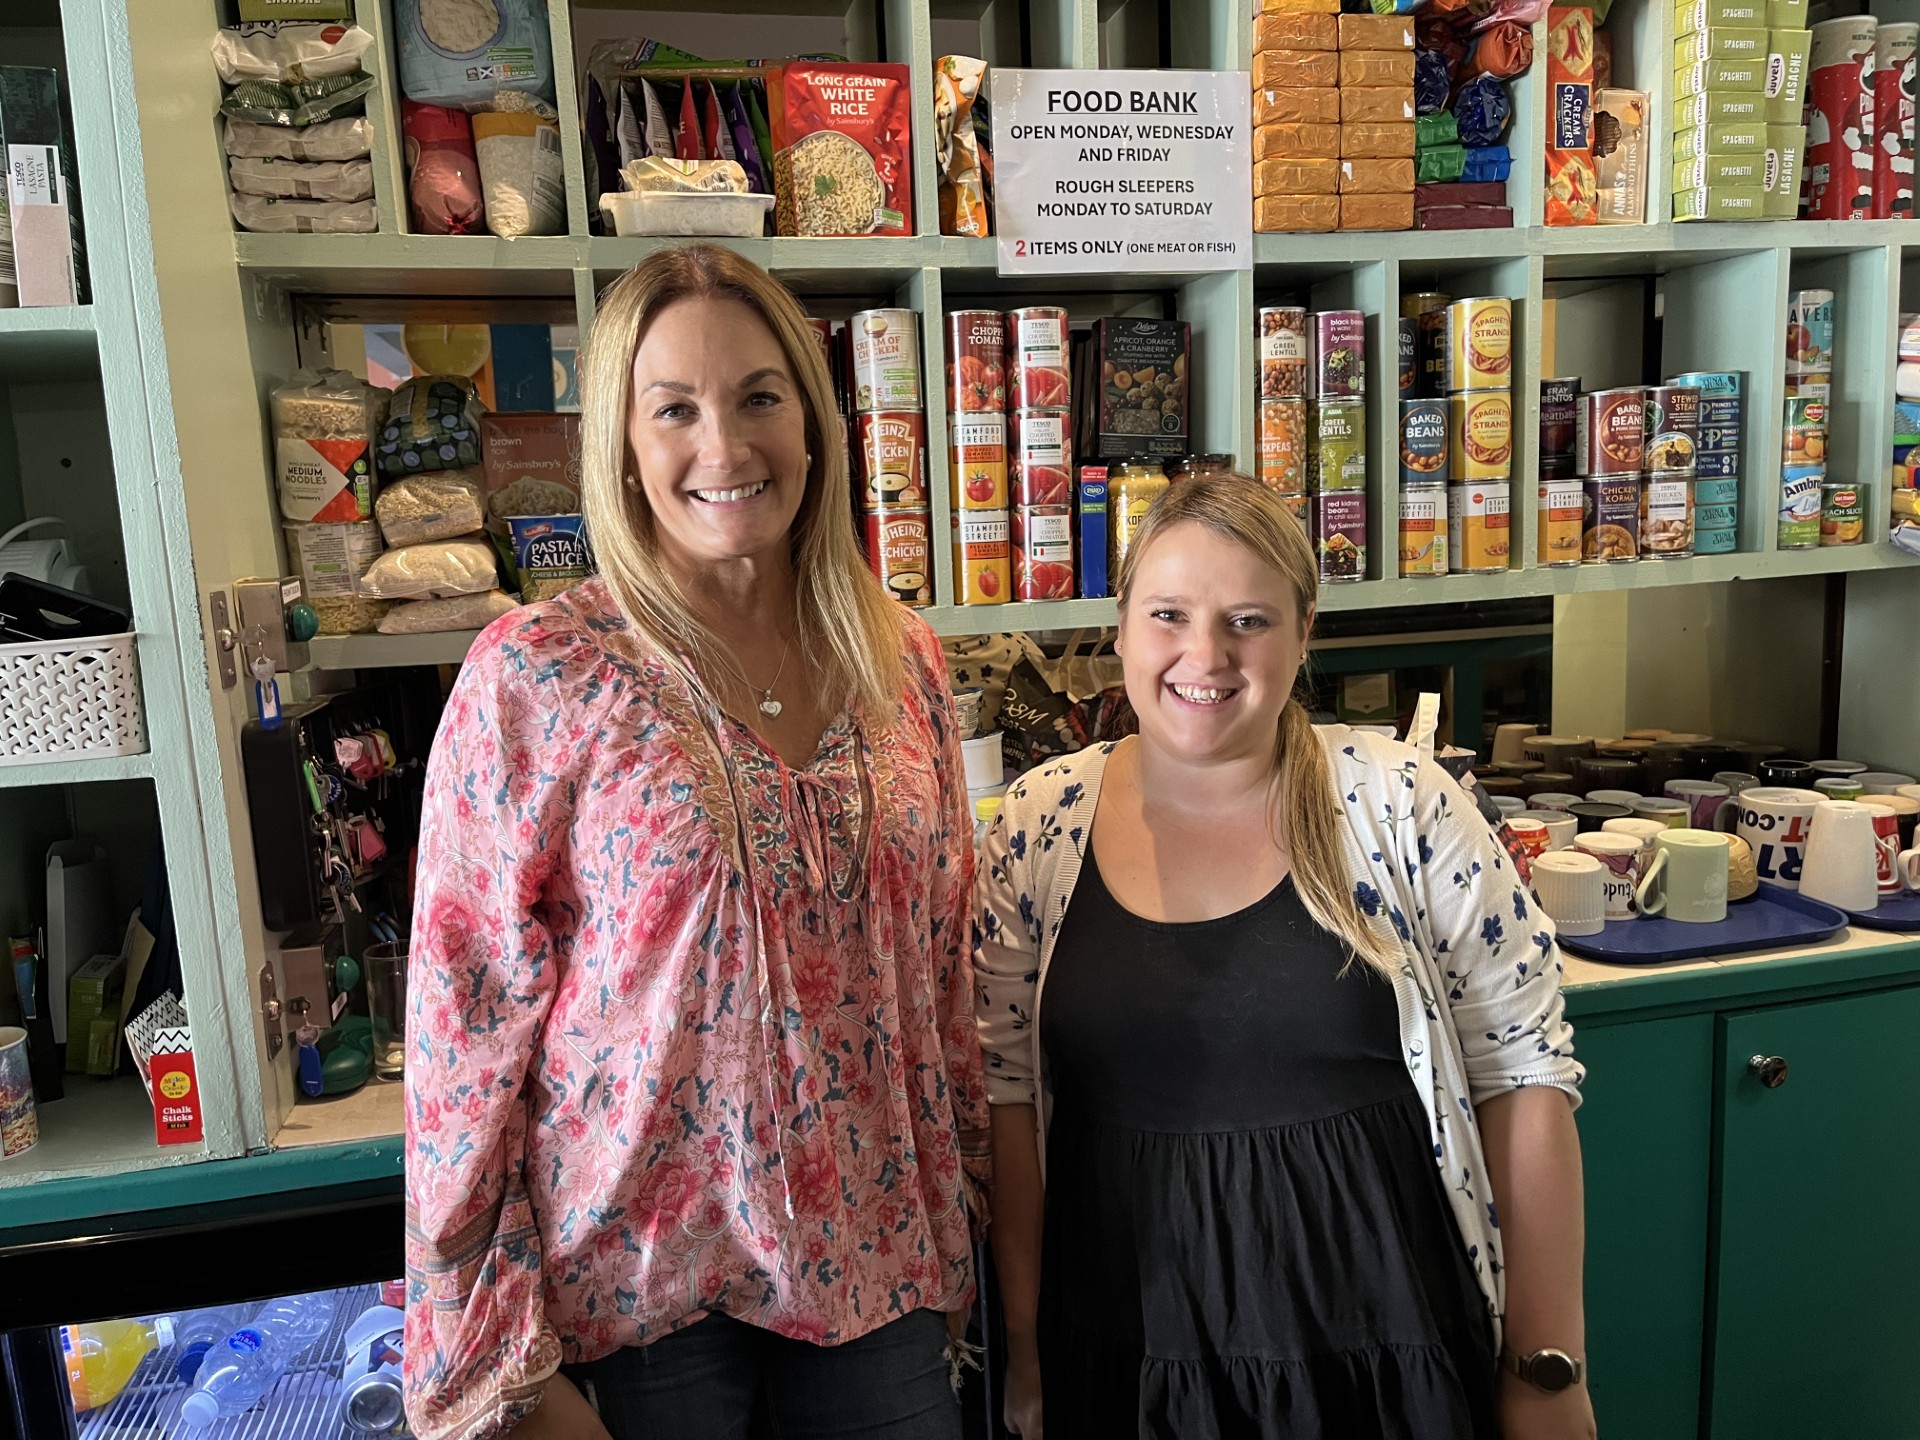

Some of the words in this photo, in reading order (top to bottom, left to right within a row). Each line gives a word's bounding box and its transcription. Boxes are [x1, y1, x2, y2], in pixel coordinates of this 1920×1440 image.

[1722, 8, 1754, 18] SPAGHETTI
[1724, 39, 1755, 49] SPAGHETTI
[808, 75, 843, 87] LONG
[846, 77, 886, 87] GRAIN
[1719, 71, 1752, 81] SPAGHETTI
[1767, 58, 1781, 94] juvela
[1784, 52, 1802, 102] LASAGNE
[820, 87, 876, 101] WHITE
[1048, 90, 1122, 113] FOOD
[1130, 91, 1198, 113] BANK
[830, 103, 868, 115] RICE
[1722, 103, 1754, 113] SPAGHETTI
[1563, 85, 1575, 146] CRACKERS
[1572, 98, 1582, 135] CREAM
[827, 118, 835, 126] by
[836, 117, 874, 126] Sainsbury's
[1010, 125, 1055, 139] OPEN
[1060, 125, 1133, 141] MONDAY,
[1136, 125, 1234, 139] WEDNESDAY
[1722, 135, 1754, 144] SPAGHETTI
[1078, 148, 1113, 162] AND
[1117, 148, 1171, 162] FRIDAY
[1629, 142, 1637, 174] THINS
[26, 154, 37, 194] LASAGNE
[884, 161, 891, 176] 2
[1721, 166, 1752, 176] SPAGHETTI
[1765, 152, 1775, 188] juvela
[1779, 147, 1795, 195] LASAGNE
[15, 162, 23, 187] TESCO
[37, 162, 46, 188] PASTA
[1055, 180, 1114, 194] ROUGH
[1118, 180, 1194, 193] SLEEPERS
[1626, 174, 1635, 217] ALMOND
[1721, 198, 1752, 208] SPAGHETTI
[1037, 203, 1107, 216] MONDAY
[1110, 202, 1130, 216] TO
[1134, 202, 1213, 215] SATURDAY
[1015, 240, 1027, 257] 2
[1030, 241, 1077, 255] ITEMS
[1081, 240, 1123, 254] ONLY
[1126, 243, 1154, 255] (ONE
[1157, 243, 1186, 253] MEAT
[1188, 243, 1204, 252] OR
[1207, 242, 1236, 254] FISH)
[971, 326, 1004, 336] CHOPP
[887, 335, 901, 344] OF
[1146, 337, 1176, 346] ORANGE
[1331, 334, 1340, 343] by
[1127, 345, 1169, 353] CRANBERRY
[1270, 348, 1298, 356] LENTILS
[1547, 387, 1568, 395] FRAY
[1541, 394, 1574, 403] BENTOS
[1671, 394, 1698, 404] STEWED
[1616, 404, 1642, 415] BAKED
[1675, 403, 1696, 411] STEAK
[1324, 418, 1345, 426] GREEN
[1410, 414, 1442, 426] BAKED
[1406, 426, 1445, 438] BEANS
[489, 437, 522, 446] brown
[492, 459, 505, 472] by
[506, 459, 561, 470] Sainsbury's
[288, 467, 323, 476] MEDIUM
[286, 475, 327, 485] NOODLES
[1601, 486, 1637, 495] CHICKEN
[1605, 495, 1635, 503] KORMA
[889, 525, 922, 538] HEINZ
[1327, 523, 1337, 531] by
[965, 532, 997, 541] STREET
[531, 540, 572, 555] PASTA
[886, 545, 925, 558] CHICKEN
[531, 552, 583, 567] SAUCE
[162, 1105, 192, 1114] Chalk
[162, 1113, 193, 1122] Sticks
